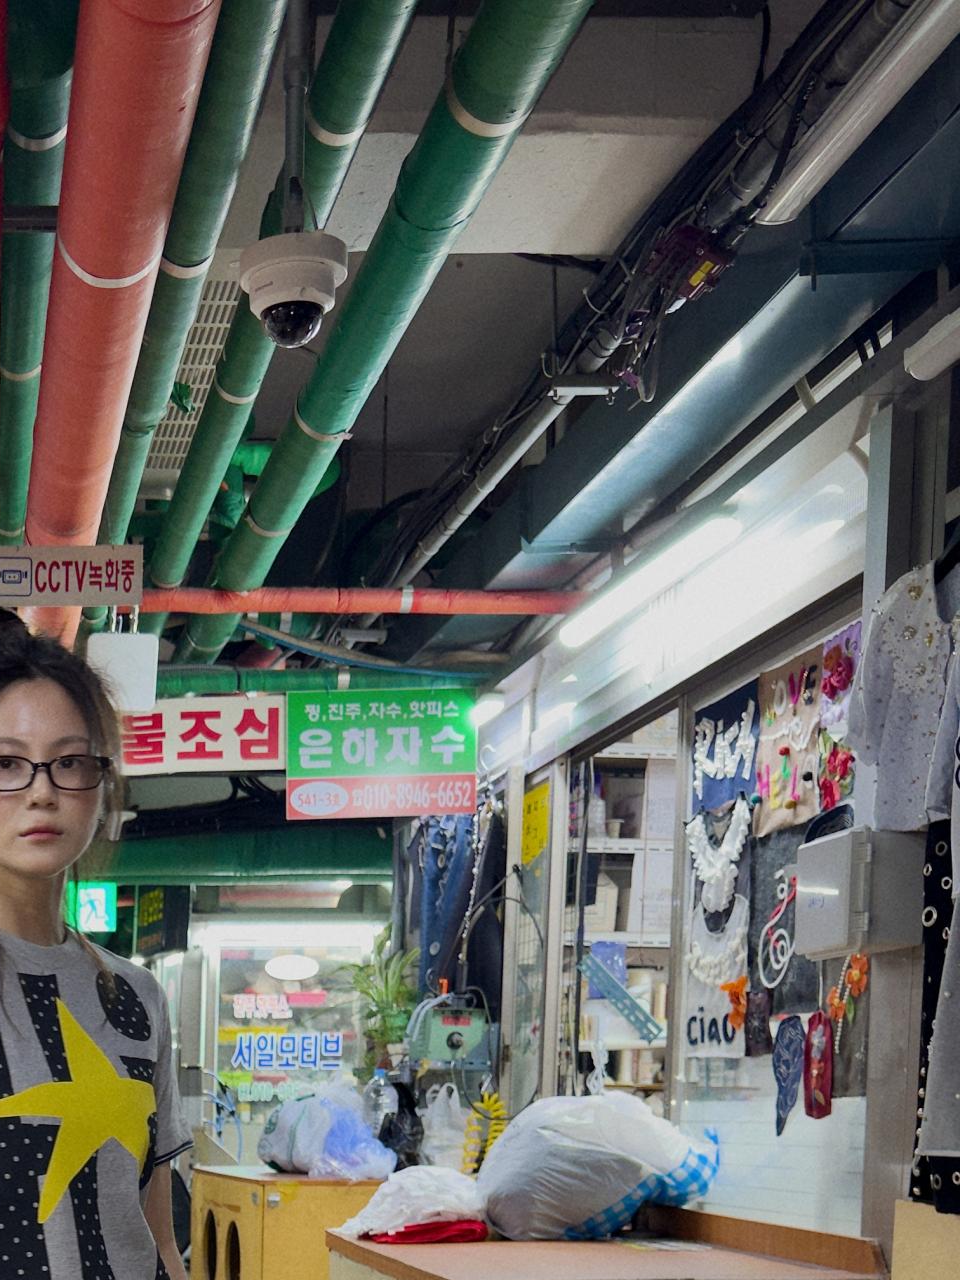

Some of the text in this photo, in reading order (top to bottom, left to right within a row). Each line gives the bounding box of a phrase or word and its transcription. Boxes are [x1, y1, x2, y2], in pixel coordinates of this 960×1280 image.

[34, 558, 135, 593] CCTV녹화중
[122, 706, 280, 765] 불조심
[298, 725, 466, 769] 은하자수
